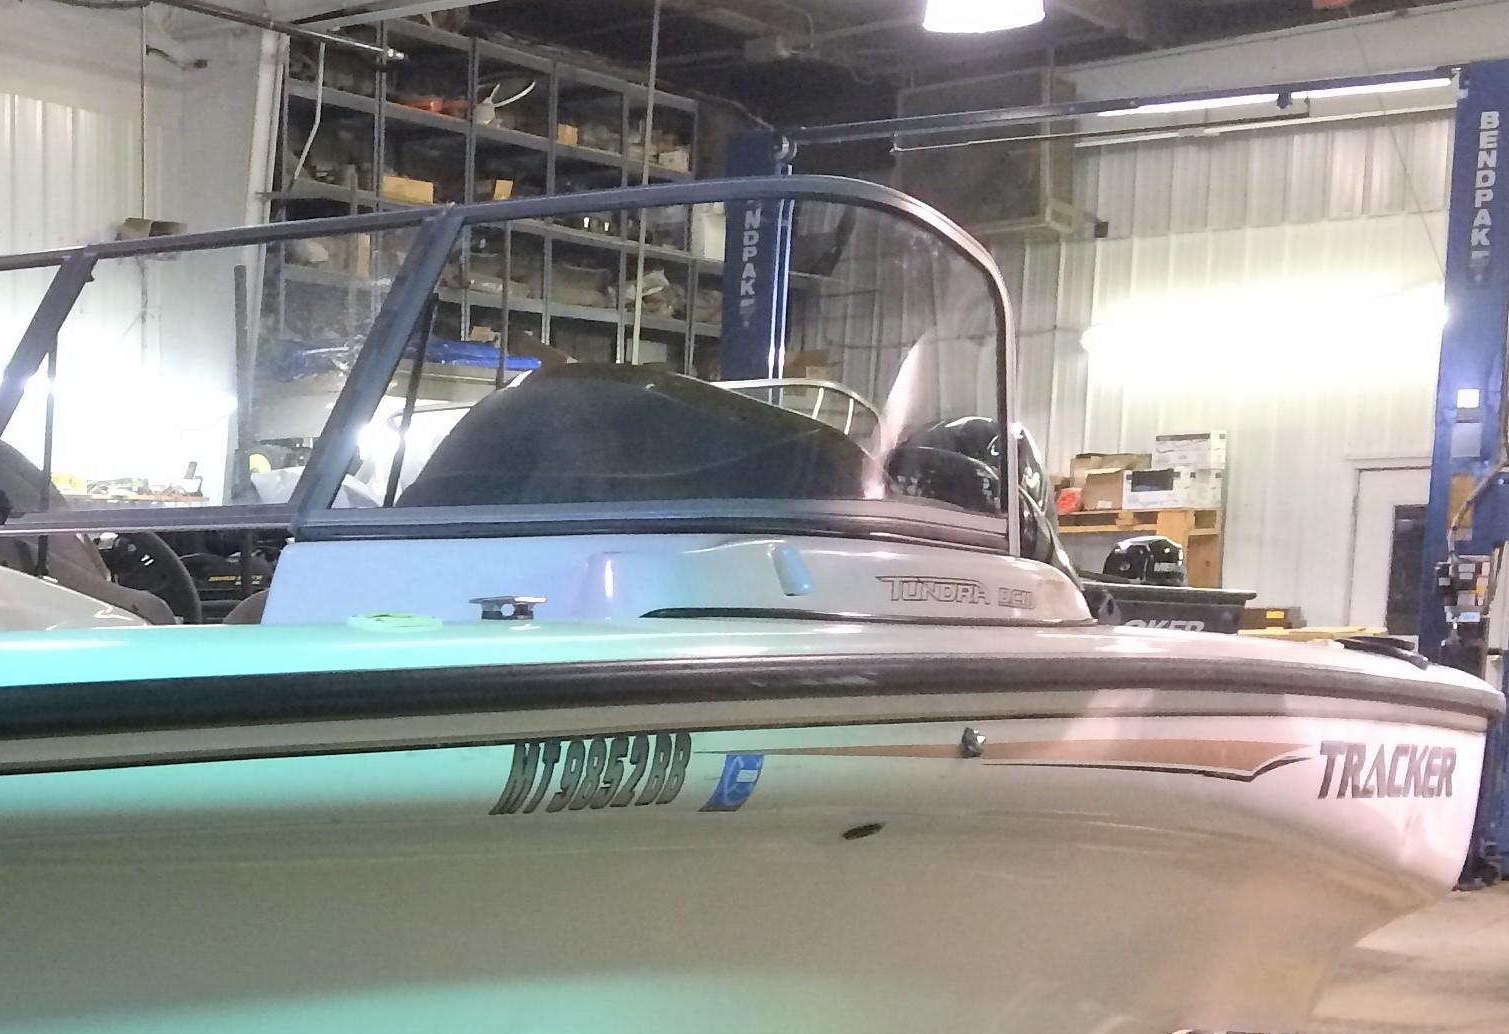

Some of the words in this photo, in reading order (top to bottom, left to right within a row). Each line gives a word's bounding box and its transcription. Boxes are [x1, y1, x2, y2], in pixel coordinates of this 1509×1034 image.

[1470, 111, 1500, 247] BENDPAK
[876, 576, 991, 605] TUNDRA
[1318, 740, 1457, 799] TRACKER
